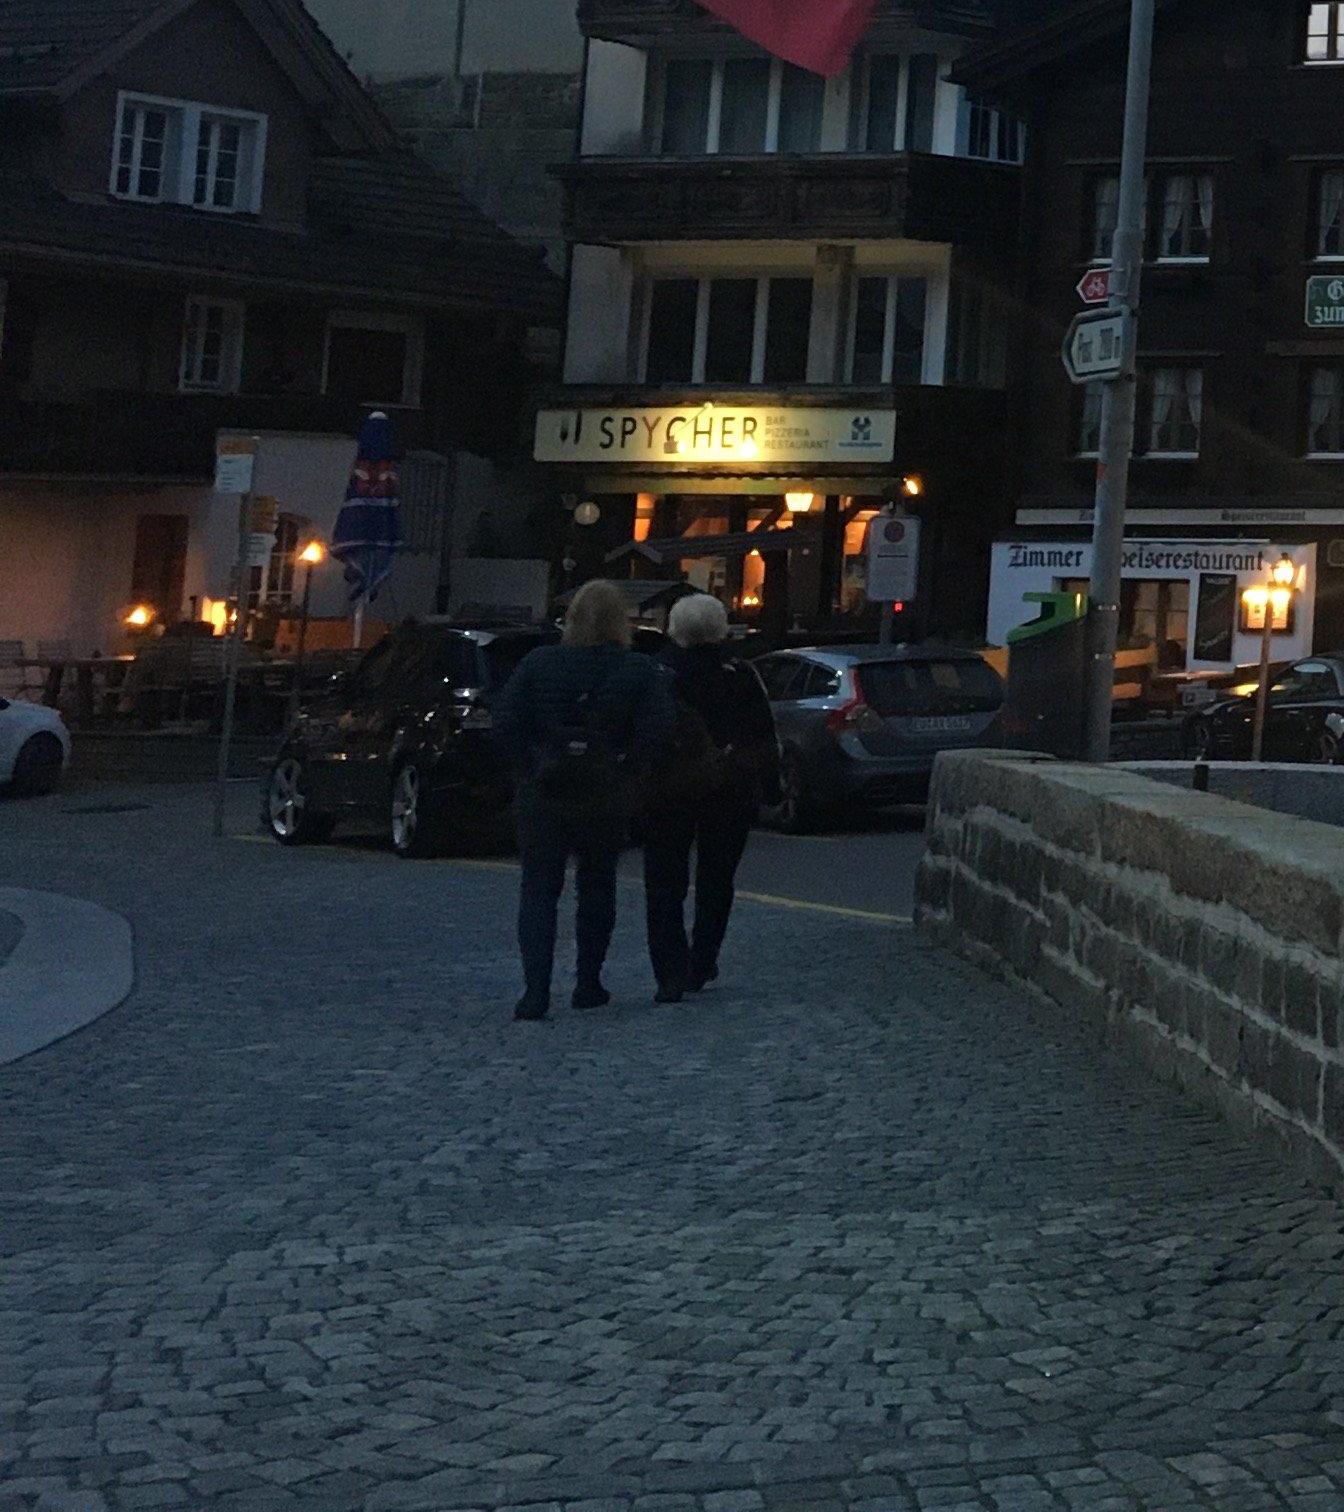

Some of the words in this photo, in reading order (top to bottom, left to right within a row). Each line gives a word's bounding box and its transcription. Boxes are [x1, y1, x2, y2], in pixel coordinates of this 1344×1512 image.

[598, 415, 759, 449] SPYCHER
[764, 439, 830, 449] RESTAURANT
[1008, 544, 1084, 569] Zimmer
